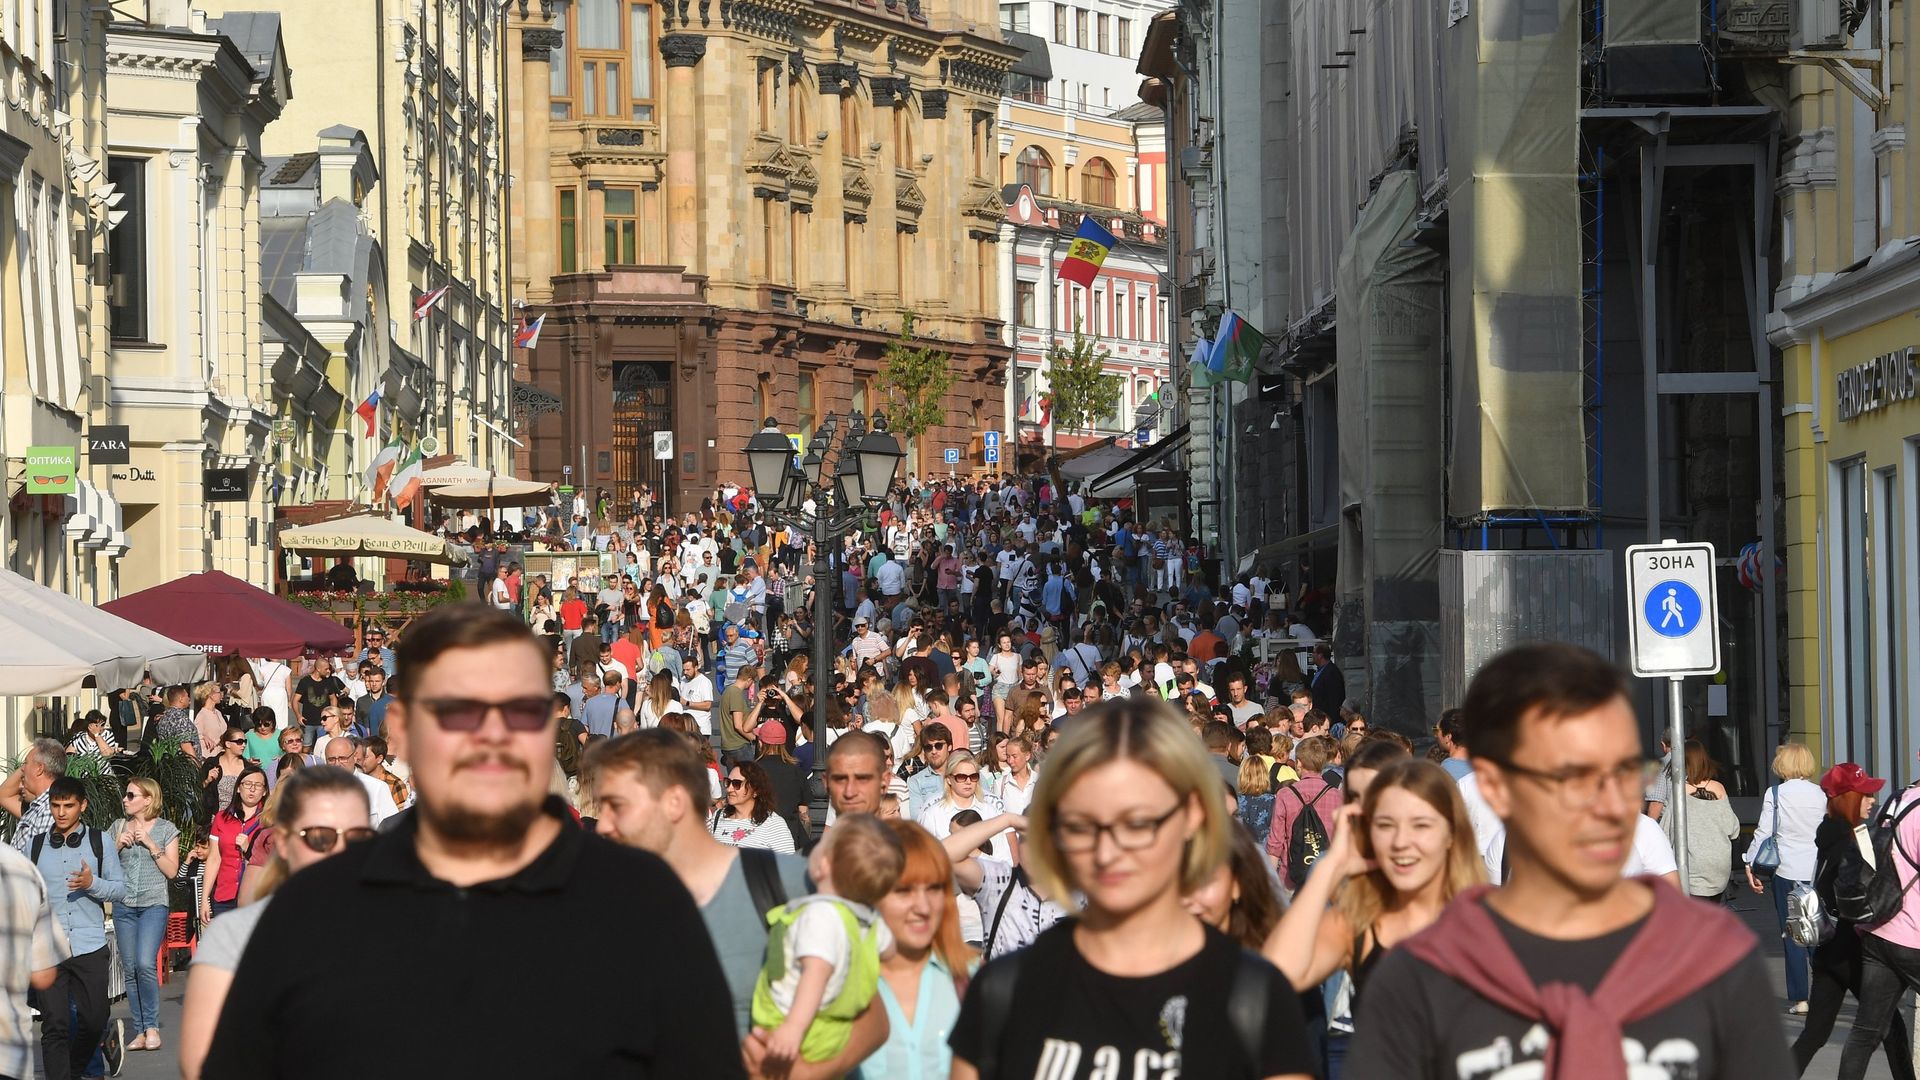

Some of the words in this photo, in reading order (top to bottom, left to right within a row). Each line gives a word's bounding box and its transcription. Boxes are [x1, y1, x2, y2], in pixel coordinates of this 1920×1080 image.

[1837, 347, 1916, 421] RENDEZ-VOUS
[91, 440, 127, 450] ZARA
[29, 456, 72, 465] ОПТИКА
[129, 467, 156, 481] Dutti
[302, 535, 329, 545] Irish
[331, 536, 356, 547] Pub
[364, 538, 389, 549] Sean
[1649, 555, 1695, 570] ЗОНА
[190, 644, 223, 653] COFFEE
